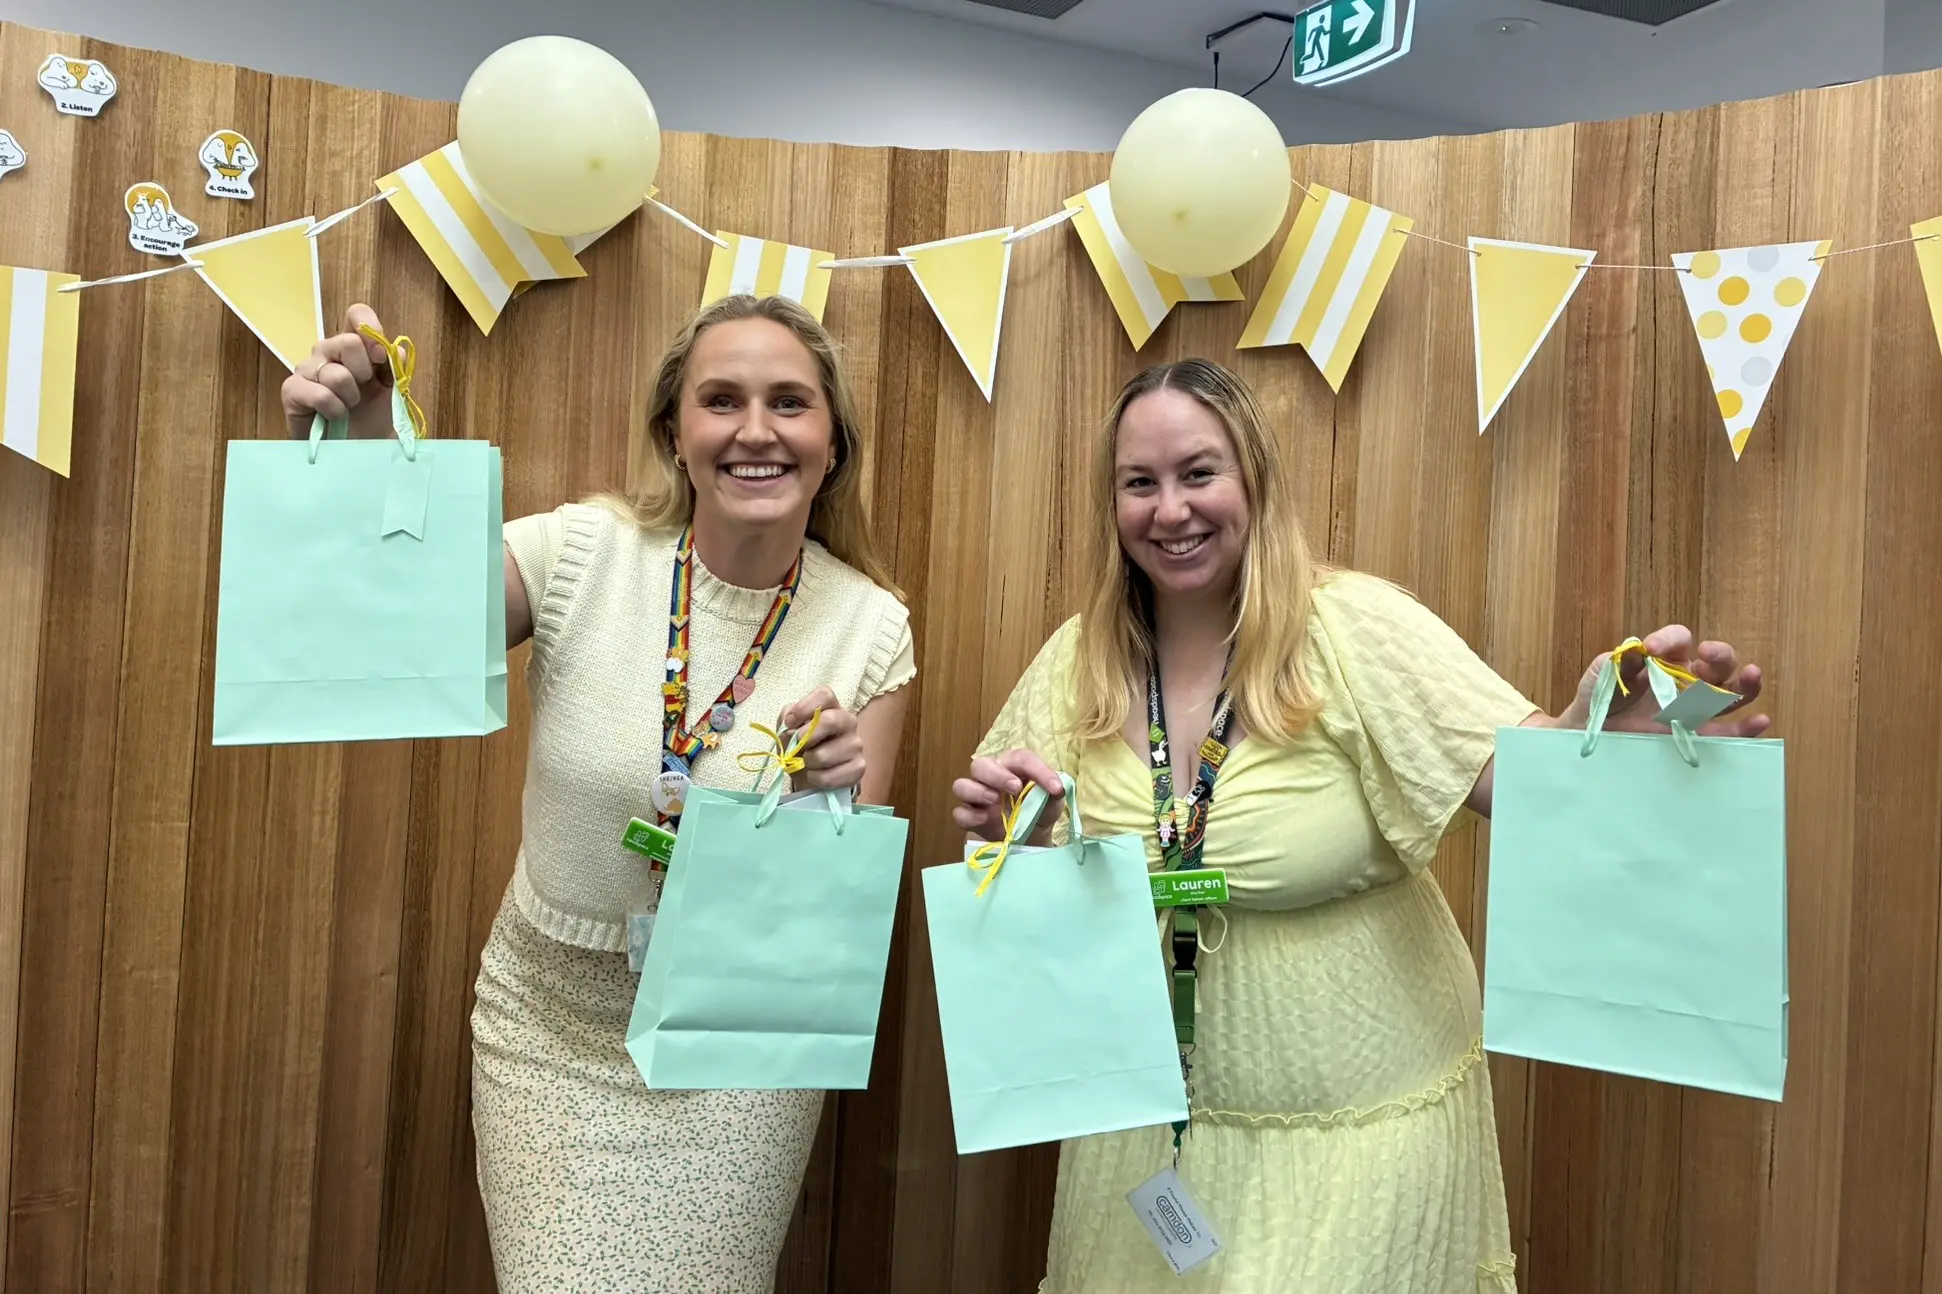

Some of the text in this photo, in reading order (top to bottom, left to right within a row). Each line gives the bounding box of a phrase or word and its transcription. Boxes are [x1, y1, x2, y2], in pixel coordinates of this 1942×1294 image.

[217, 186, 239, 194] Check
[131, 233, 180, 248] 3. Encourage
[143, 243, 168, 251] action
[1172, 879, 1221, 891] Lauren
